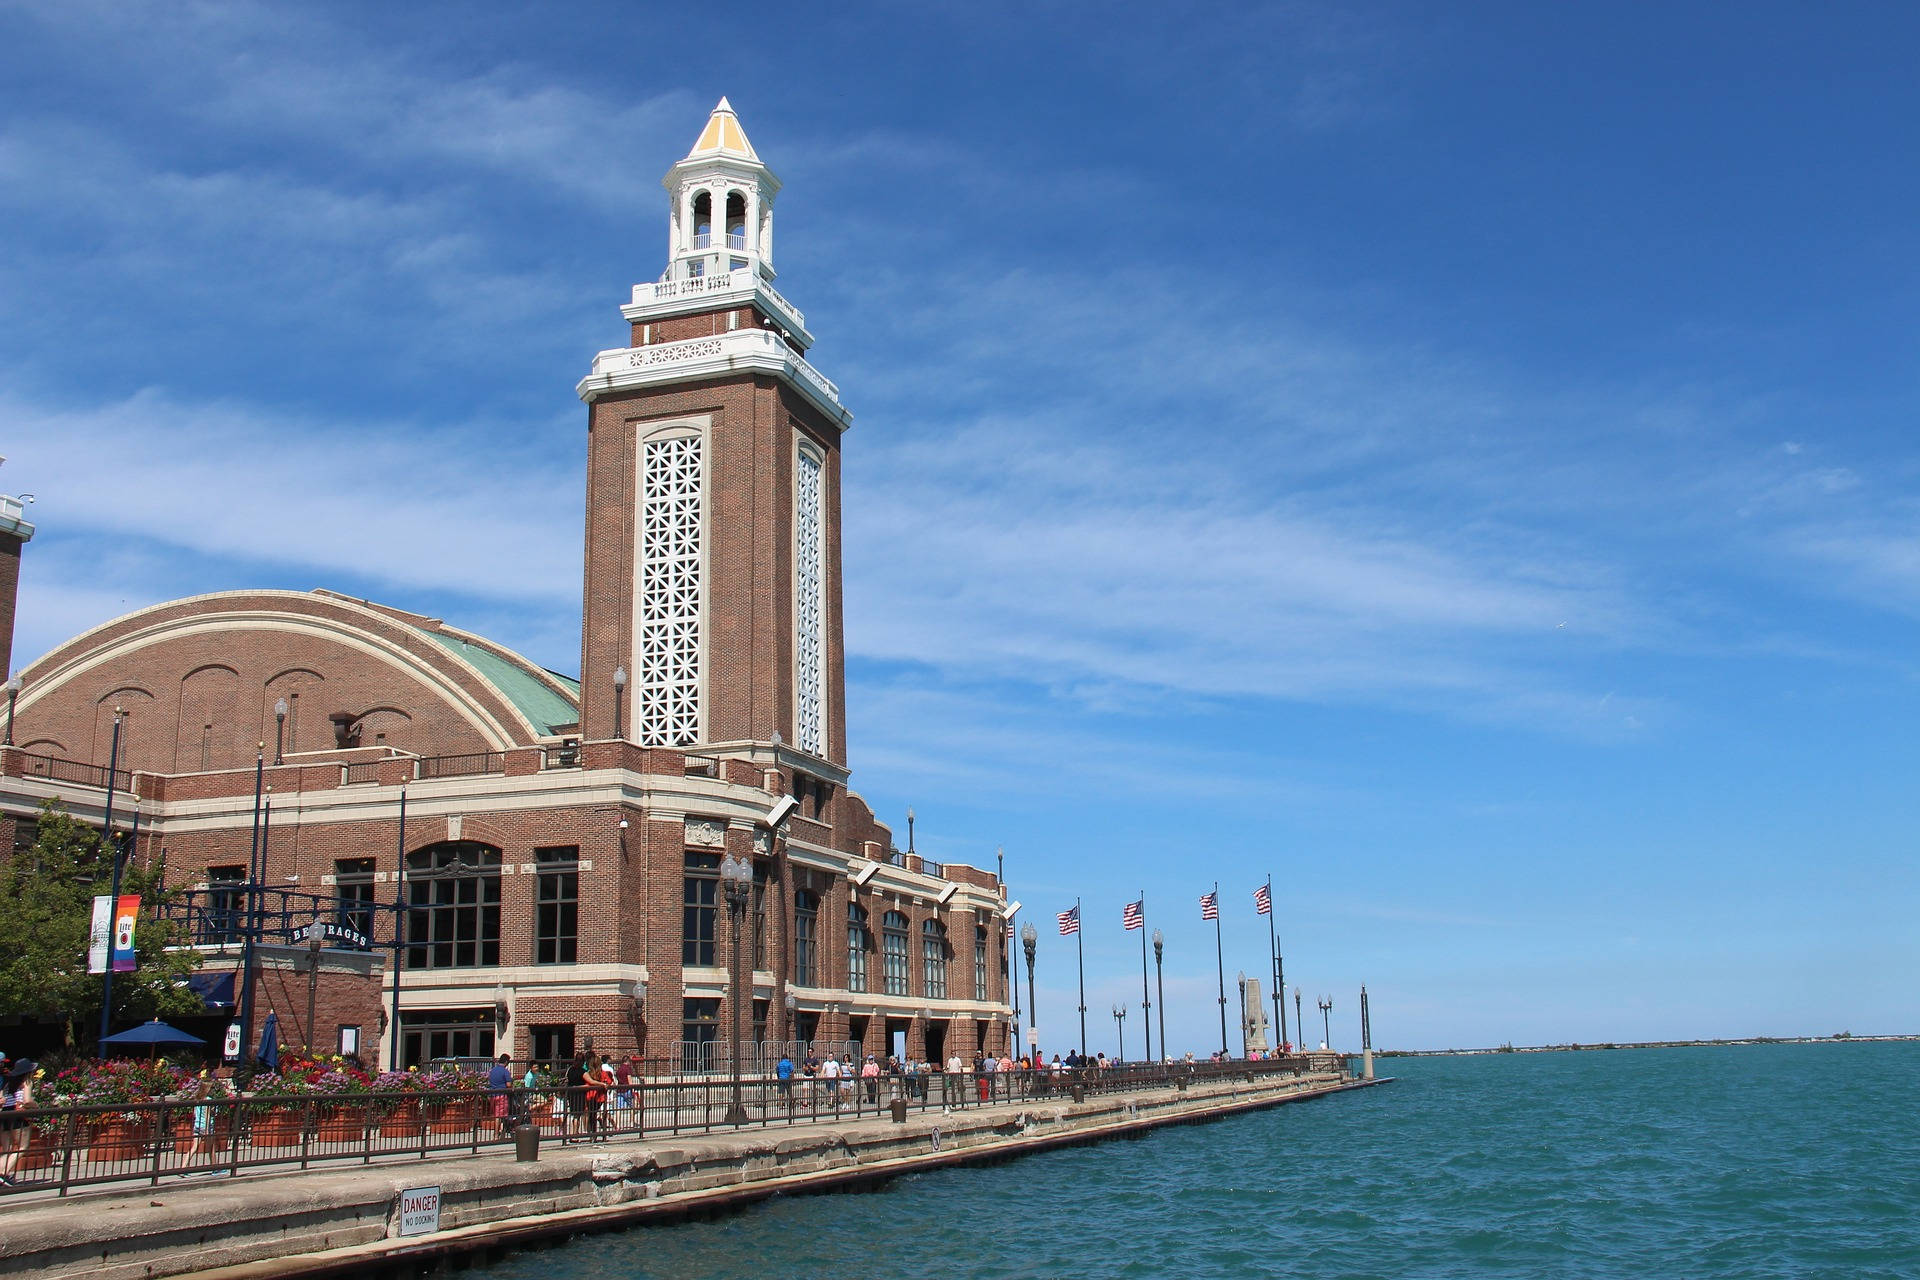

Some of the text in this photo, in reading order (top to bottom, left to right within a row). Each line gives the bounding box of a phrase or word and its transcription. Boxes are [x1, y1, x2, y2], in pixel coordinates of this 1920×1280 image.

[120, 923, 132, 933] Lite
[293, 924, 367, 946] BERAGES
[404, 1195, 437, 1214] DANGER
[405, 1214, 435, 1226] NO DOCKING
